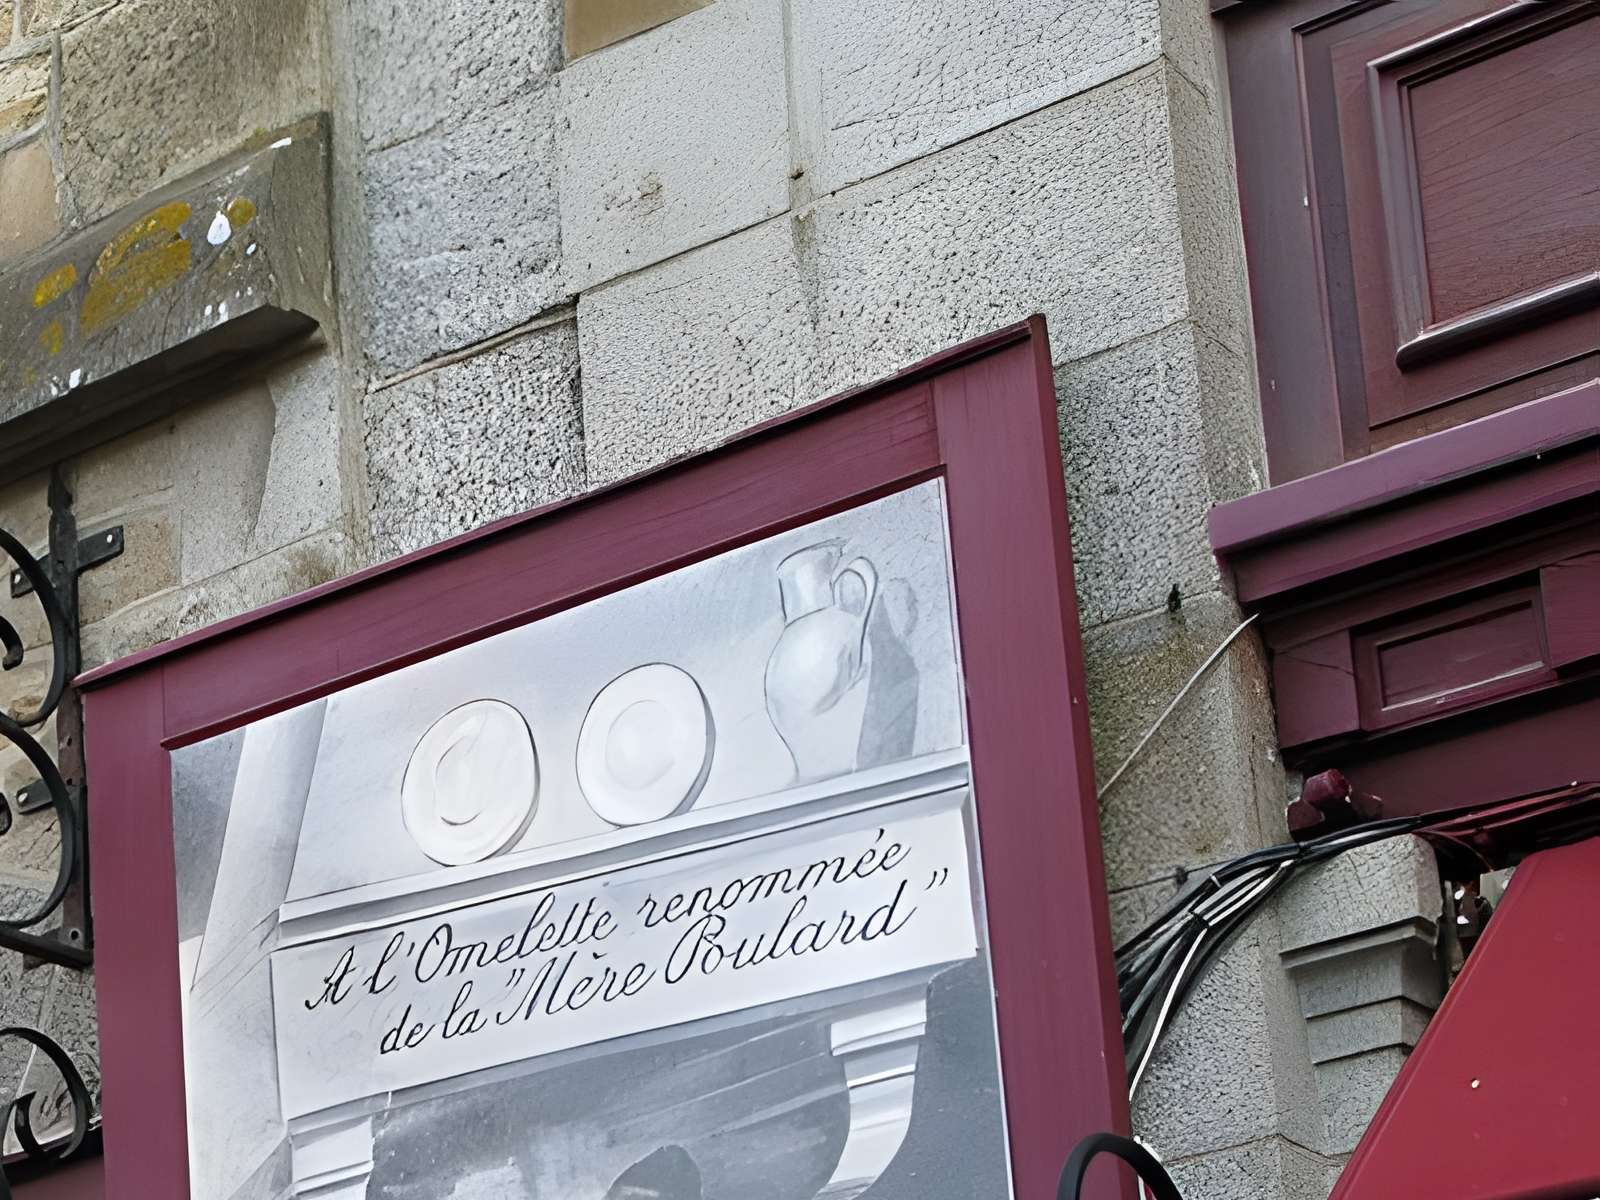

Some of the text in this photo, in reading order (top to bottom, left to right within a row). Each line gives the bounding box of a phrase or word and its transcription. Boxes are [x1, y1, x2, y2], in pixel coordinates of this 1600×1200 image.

[304, 828, 912, 1010] A l'Omelette renommée
[379, 1003, 435, 1056] de
[440, 980, 488, 1039] la
